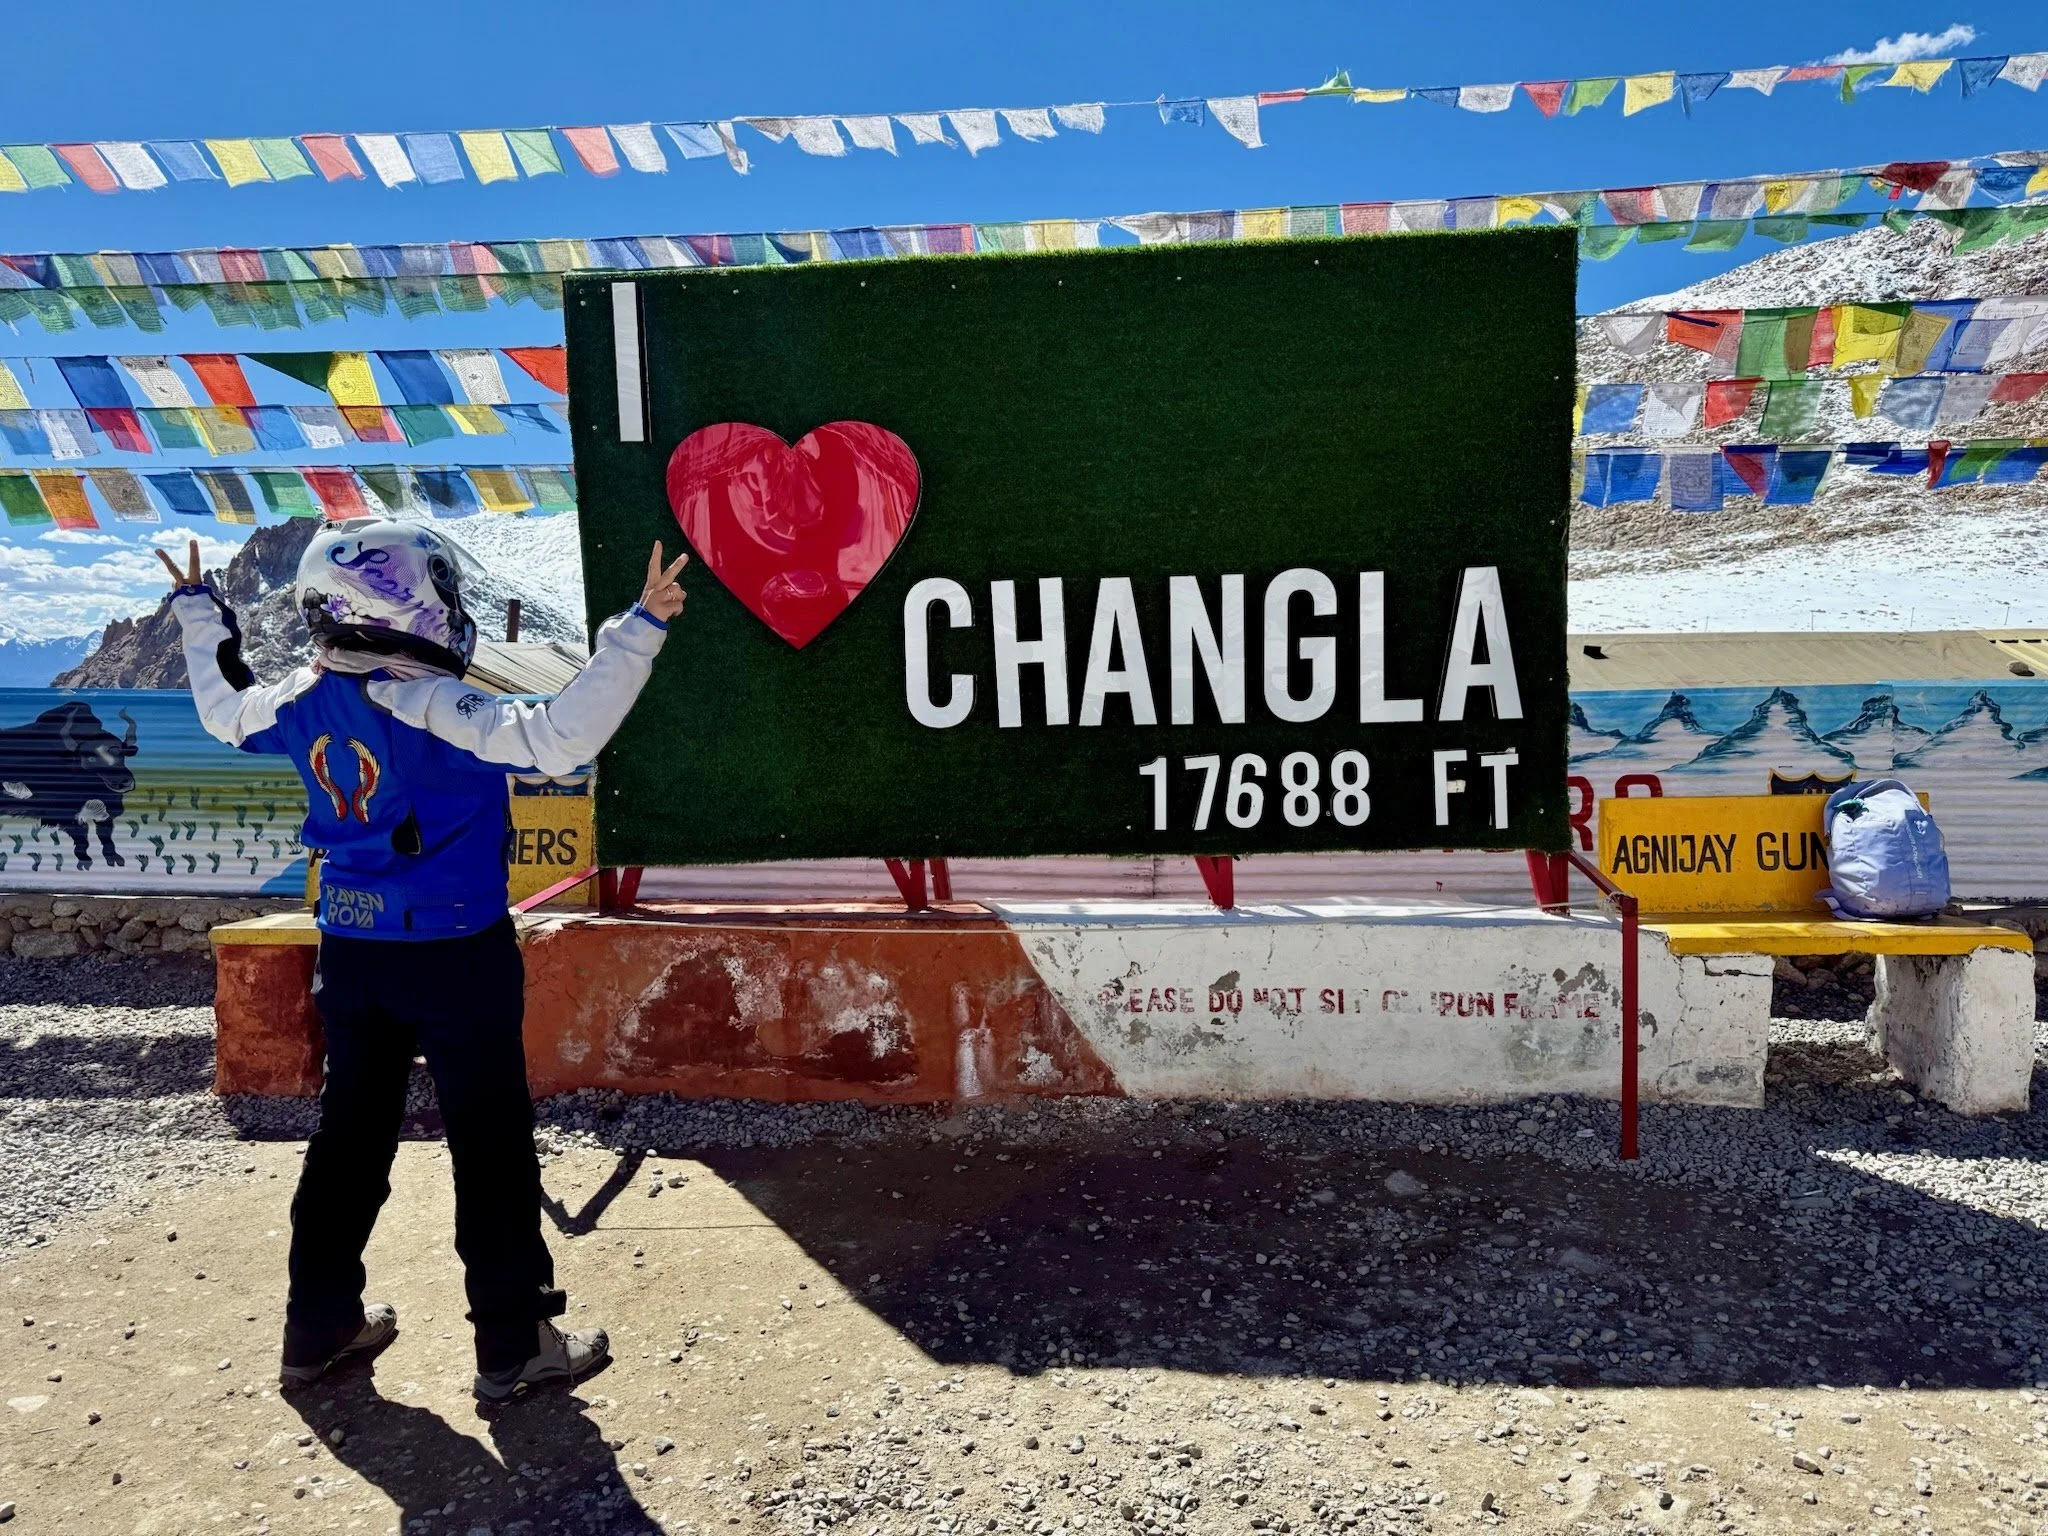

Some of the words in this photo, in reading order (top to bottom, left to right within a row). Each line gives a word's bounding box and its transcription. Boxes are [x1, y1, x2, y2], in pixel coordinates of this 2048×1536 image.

[612, 282, 646, 442] I
[904, 566, 1524, 729] CHANGLA
[1139, 750, 1371, 831] 17688
[1433, 749, 1520, 830] FT
[1612, 833, 1737, 873] AGNIJAY
[1756, 832, 1830, 871] GUN
[325, 884, 384, 912] RAVEN
[1208, 988, 1243, 1013] DO
